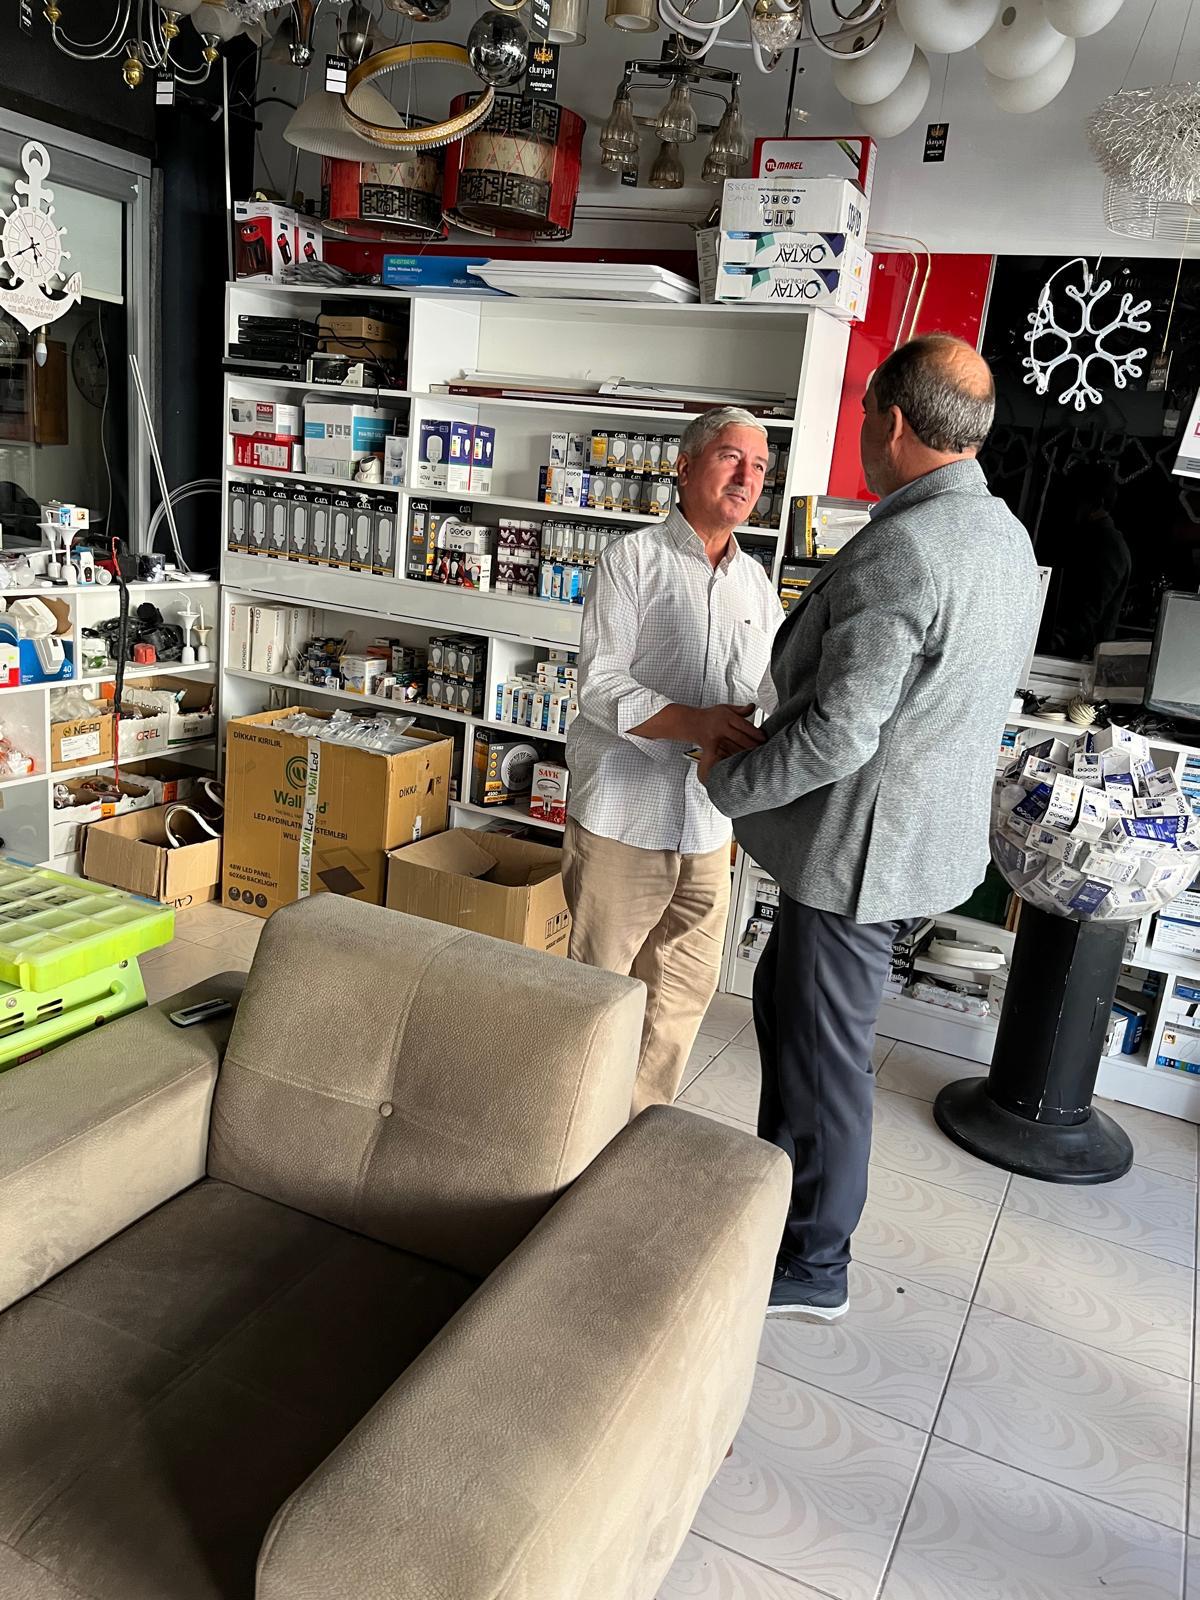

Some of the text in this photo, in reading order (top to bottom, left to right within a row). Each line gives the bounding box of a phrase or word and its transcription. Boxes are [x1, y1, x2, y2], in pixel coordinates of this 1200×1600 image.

[528, 64, 556, 79] duman
[777, 161, 804, 170] MAKEL
[774, 244, 827, 264] OKTAY
[770, 279, 821, 299] OKTAY
[411, 502, 429, 511] CATA
[63, 665, 72, 673] 40
[233, 731, 257, 742] DİKKAT
[538, 768, 560, 779] SAVK
[253, 812, 266, 821] LED
[267, 815, 303, 830] AYDINLATM
[241, 866, 253, 874] LED
[253, 868, 272, 879] PANEL
[247, 875, 278, 889] BACKLIGHT
